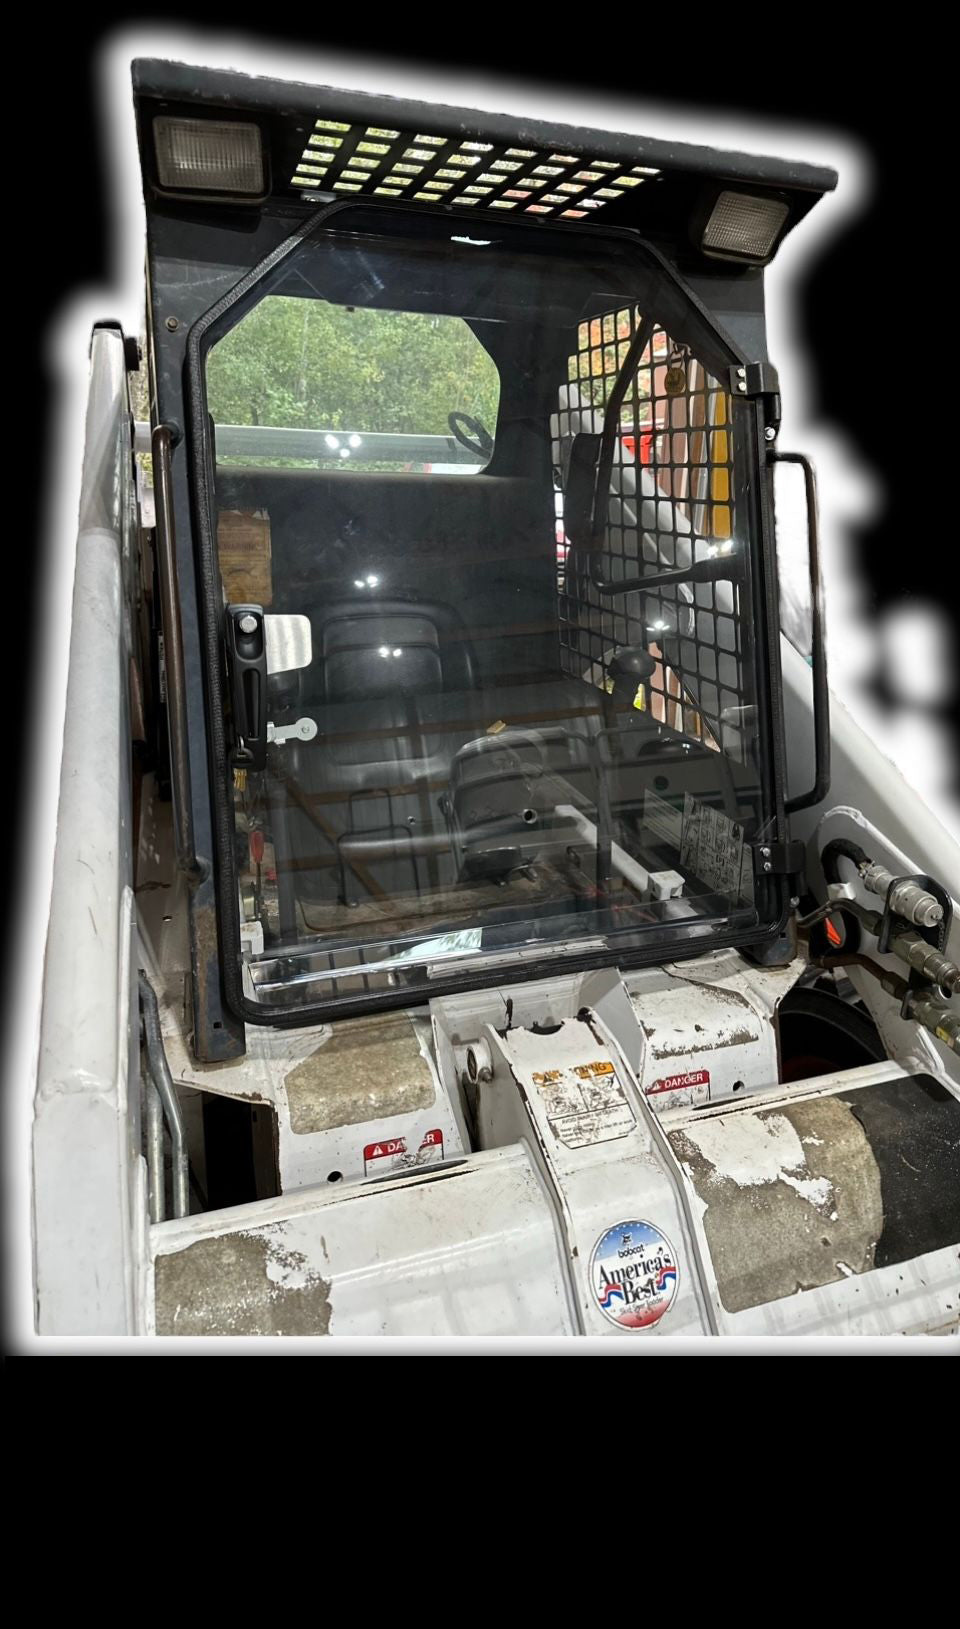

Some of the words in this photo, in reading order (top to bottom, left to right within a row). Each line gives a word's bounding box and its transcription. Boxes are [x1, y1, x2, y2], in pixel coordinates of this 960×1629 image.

[664, 1073, 703, 1088] DANGER
[618, 1244, 645, 1258] bobcat
[599, 1246, 672, 1289] America's
[622, 1277, 658, 1305] Best
